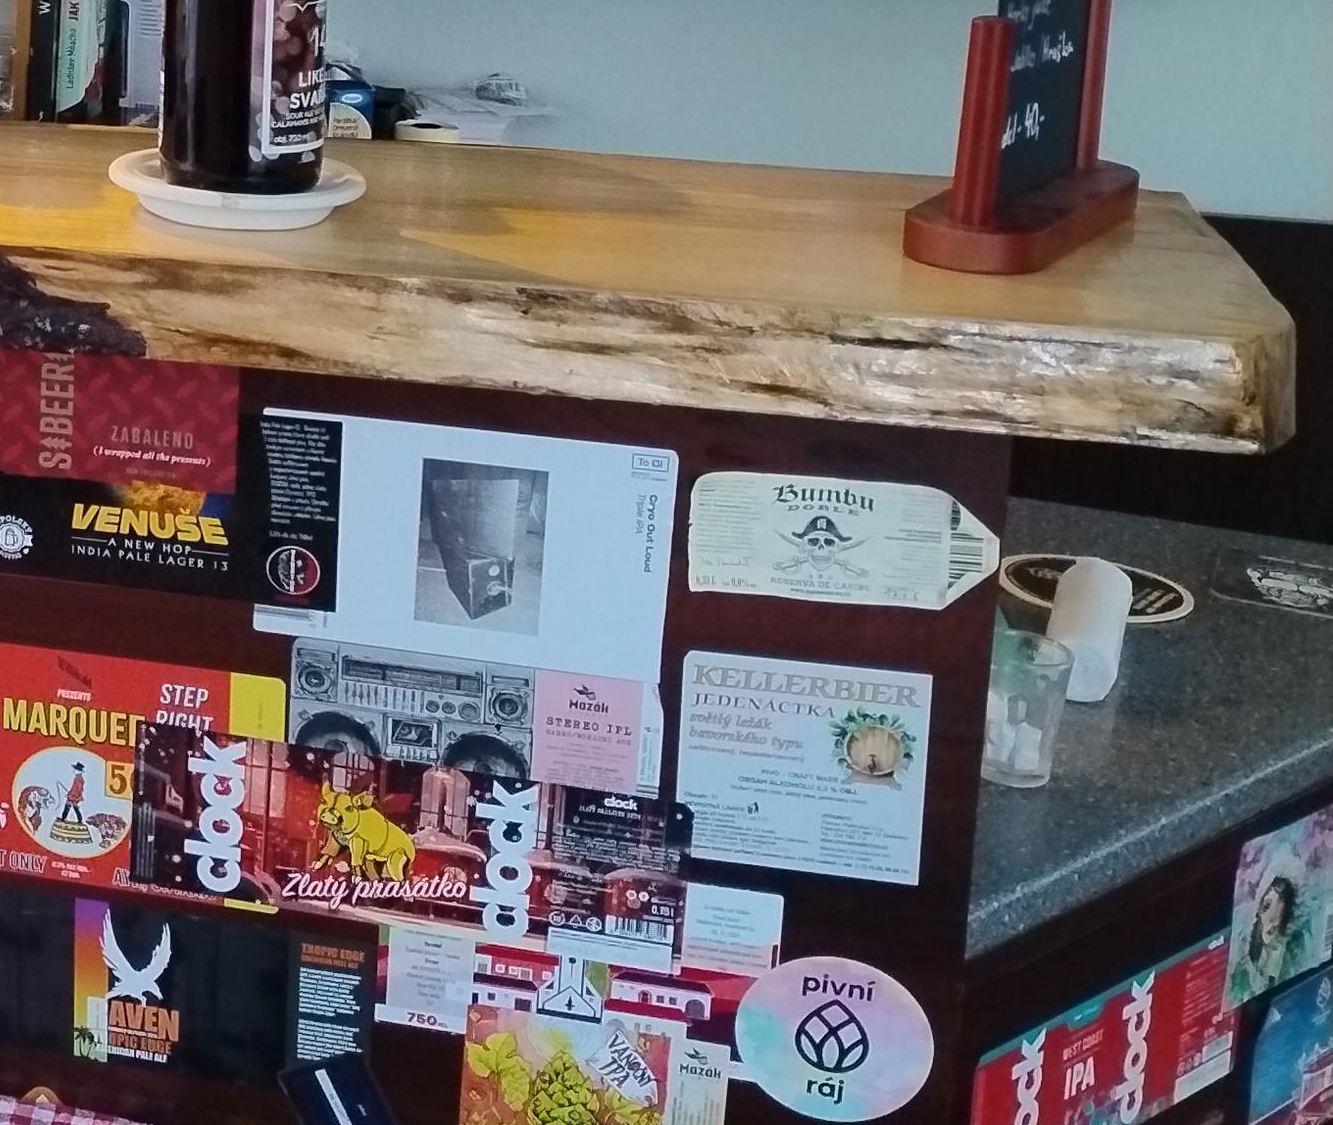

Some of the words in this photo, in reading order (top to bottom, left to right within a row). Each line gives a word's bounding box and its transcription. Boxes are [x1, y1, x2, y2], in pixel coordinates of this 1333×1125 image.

[69, 0, 80, 22] JAK
[647, 493, 659, 521] Cryo
[773, 483, 875, 513] Bumbu
[71, 502, 229, 547] VENUŠE
[645, 522, 657, 543] Out
[71, 544, 111, 560] INDIA
[117, 549, 152, 564] PALE
[158, 555, 206, 569] LAGER
[123, 539, 155, 551] NEW
[163, 544, 192, 555] HOP
[643, 544, 655, 573] Loud
[160, 683, 209, 707] STEP
[692, 664, 922, 708] KELLERBIER
[691, 691, 836, 718] JEDENÁCTKA
[546, 716, 600, 732] STEREO
[606, 724, 632, 737] IPL
[185, 735, 247, 893] clock
[604, 796, 638, 811] clock
[10, 848, 47, 873] ONLY
[470, 779, 540, 940] clock
[282, 872, 347, 911] Zlatý
[349, 873, 467, 907] prasátko
[801, 973, 875, 1004] pivní
[407, 1010, 437, 1025] 750
[805, 1077, 844, 1104] ráj
[1063, 1056, 1096, 1101] IPA
